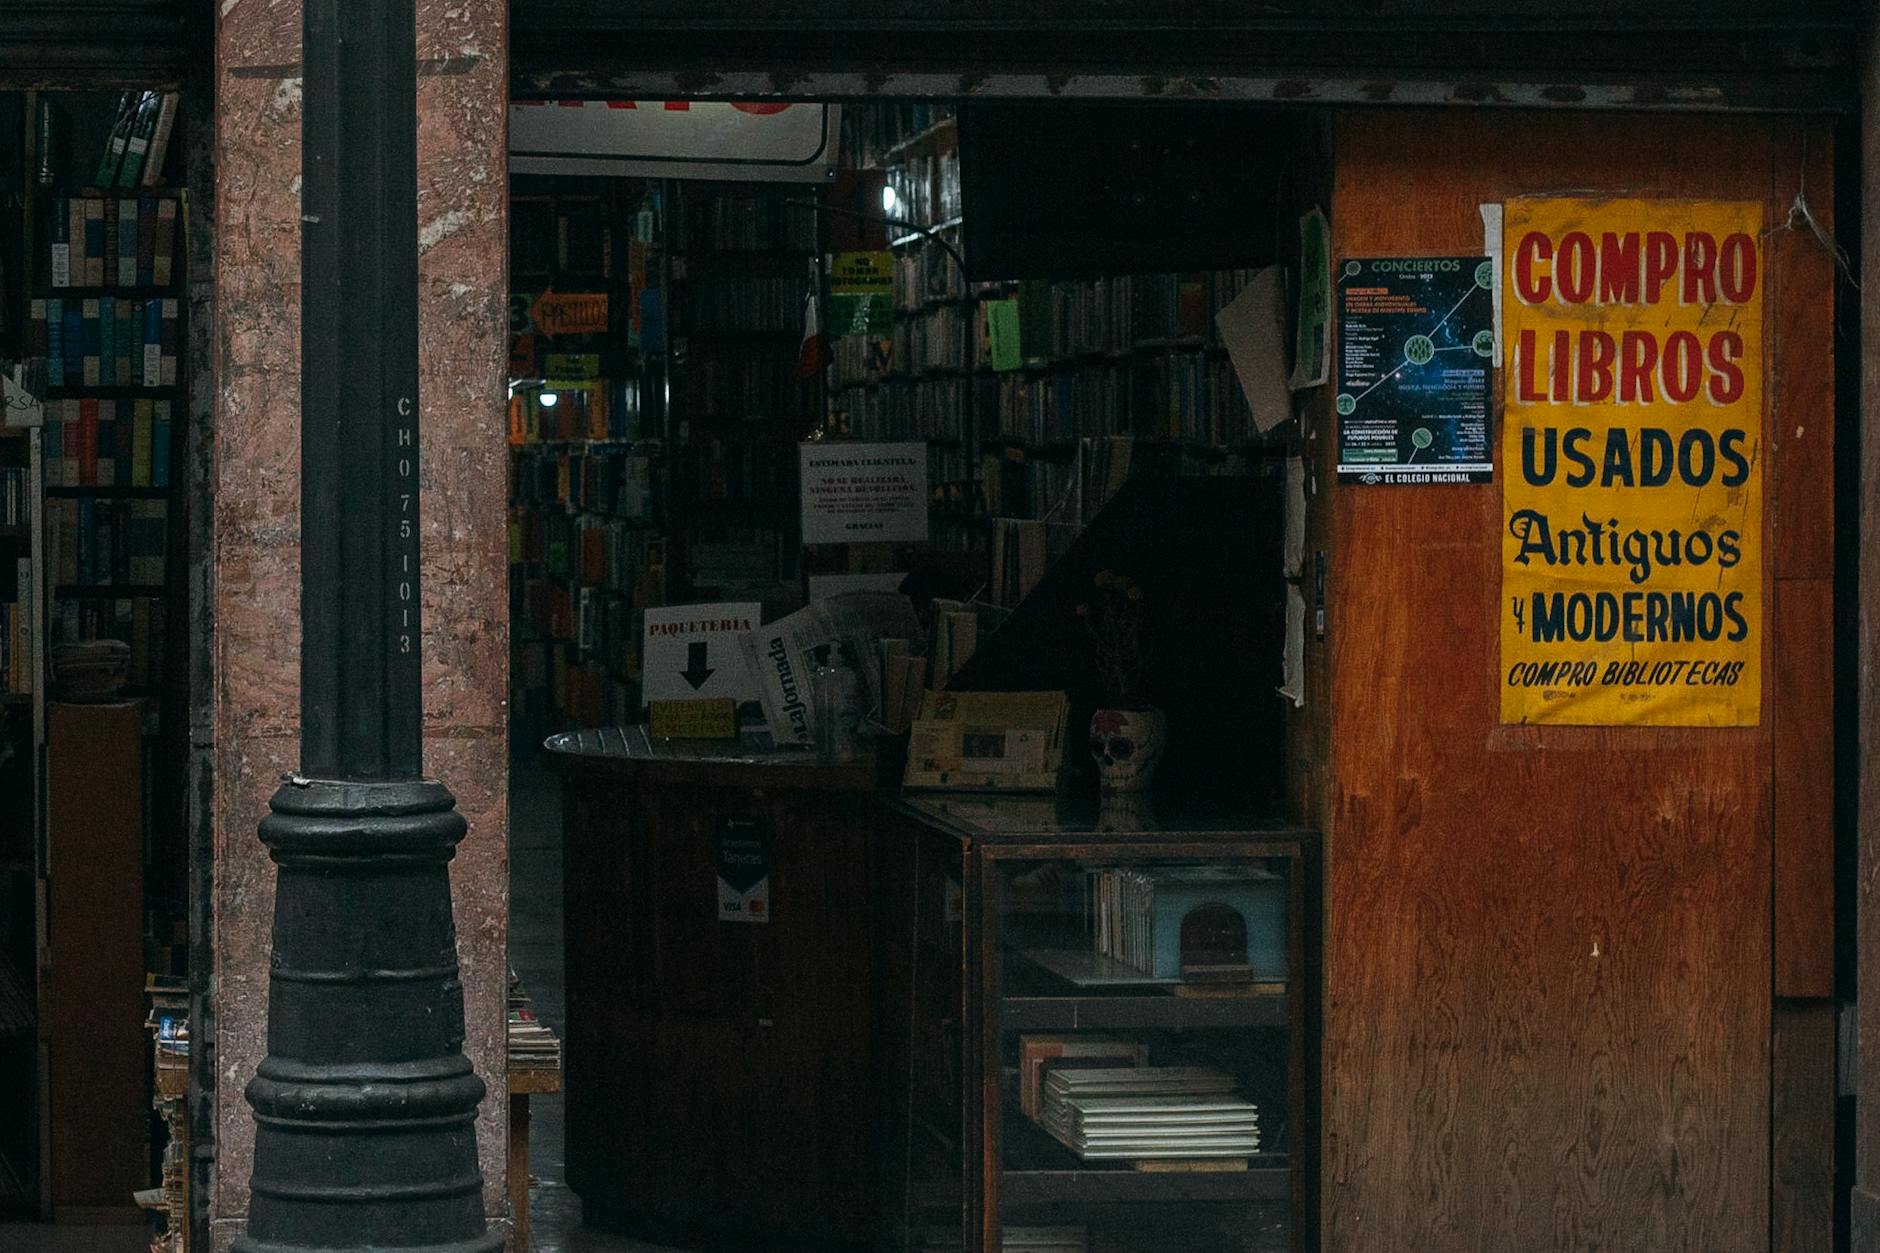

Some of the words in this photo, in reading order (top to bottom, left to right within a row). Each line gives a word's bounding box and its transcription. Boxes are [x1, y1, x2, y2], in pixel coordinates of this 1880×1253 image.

[1371, 260, 1461, 273] CONCIERTOS
[1512, 231, 1757, 306] COMPRO
[1515, 329, 1745, 405] LIBROS
[1522, 427, 1749, 488] USADOS
[1385, 474, 1394, 483] EL
[1396, 473, 1431, 483] COLEGIO
[1432, 473, 1471, 483] NACIONAL
[845, 522, 884, 530] GRACIAS
[1509, 509, 1742, 584] Antiguos
[1532, 591, 1748, 643] MODERNOS
[1508, 660, 1598, 688] COMPRO
[1601, 660, 1745, 688] BIBLIOTECAS
[723, 902, 742, 912] VISA
